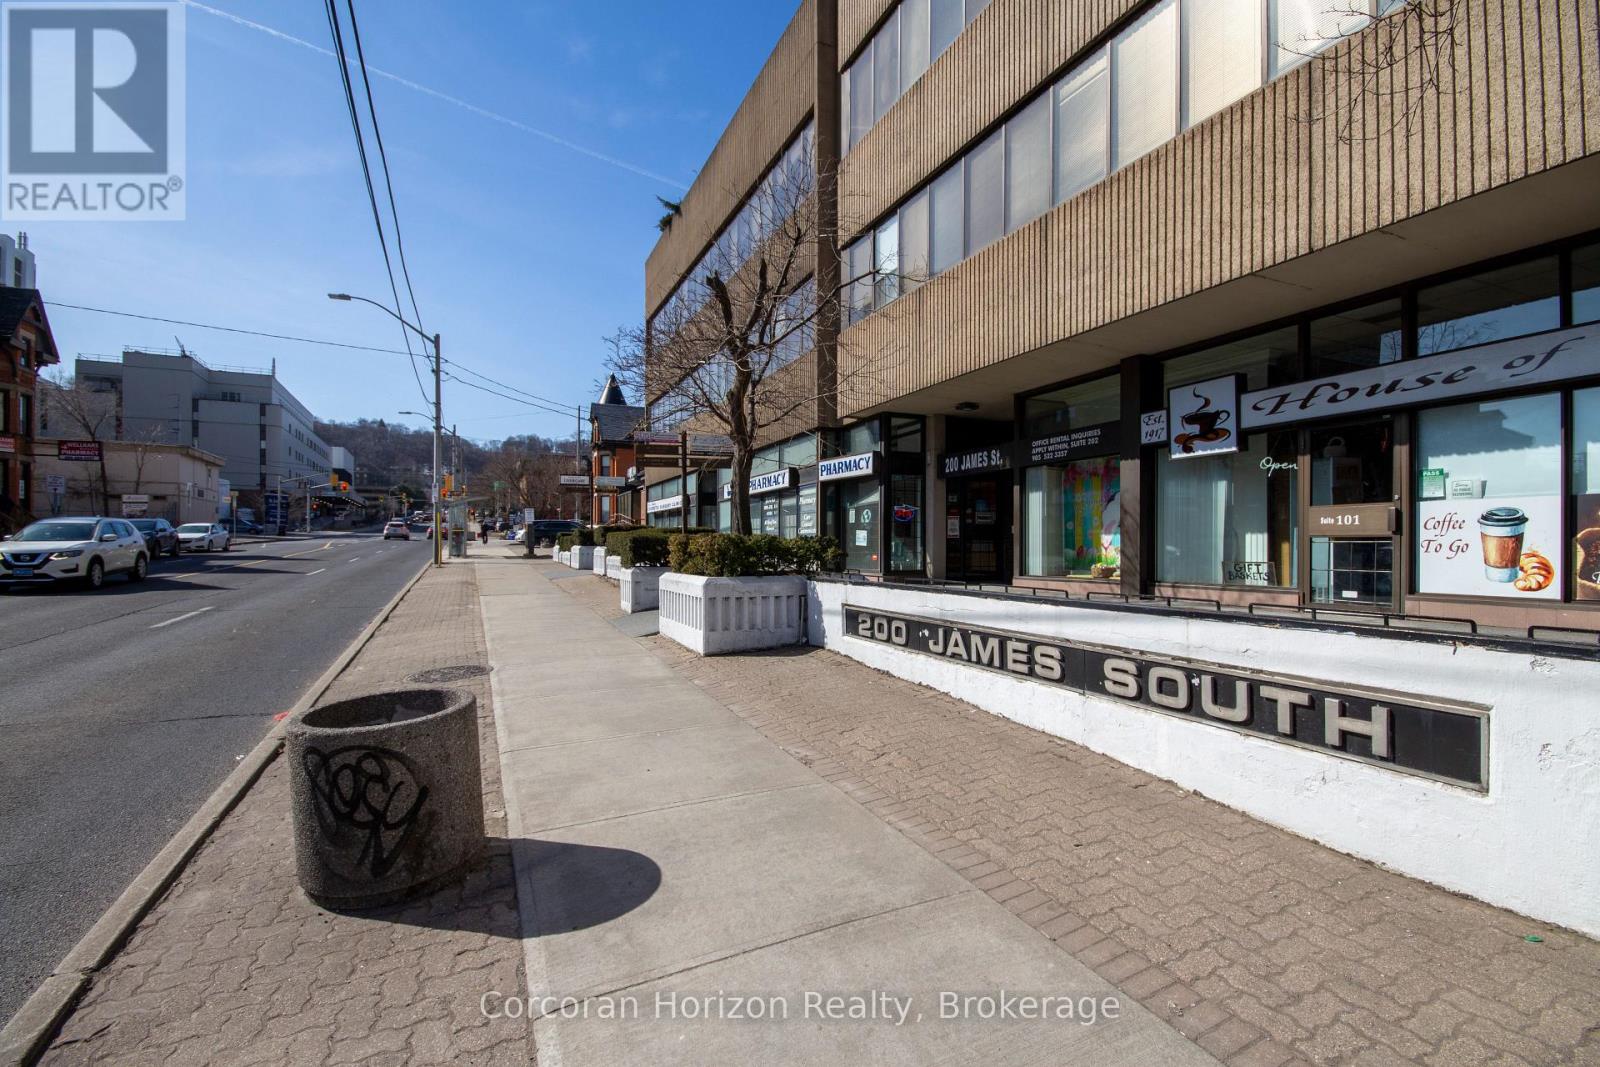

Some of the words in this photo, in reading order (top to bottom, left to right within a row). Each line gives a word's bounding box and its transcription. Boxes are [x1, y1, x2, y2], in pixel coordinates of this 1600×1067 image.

[1252, 365, 1477, 416] House
[1503, 336, 1586, 378] of
[1143, 414, 1165, 426] Est.
[1031, 438, 1049, 447] OFFICE
[1050, 434, 1070, 444] RENTAL
[1070, 428, 1102, 440] INQUIRIES
[1031, 446, 1047, 454] APPLY
[1070, 439, 1087, 448] SUITE
[820, 456, 871, 476] PHARMACY
[945, 456, 959, 473] 200
[961, 451, 988, 471] JAMES
[1260, 456, 1299, 477] Open
[750, 472, 786, 491] PHARMACY
[1320, 516, 1335, 525] Suite
[1335, 514, 1360, 526] 101
[1423, 512, 1466, 537] Coffee
[1420, 539, 1443, 554] To
[1446, 539, 1470, 560] Go
[1228, 570, 1270, 581] BASKETS
[1233, 563, 1262, 574] GIFT
[857, 615, 908, 646] 200
[928, 629, 1065, 680] JAMES
[1104, 658, 1393, 759] SOUTH
